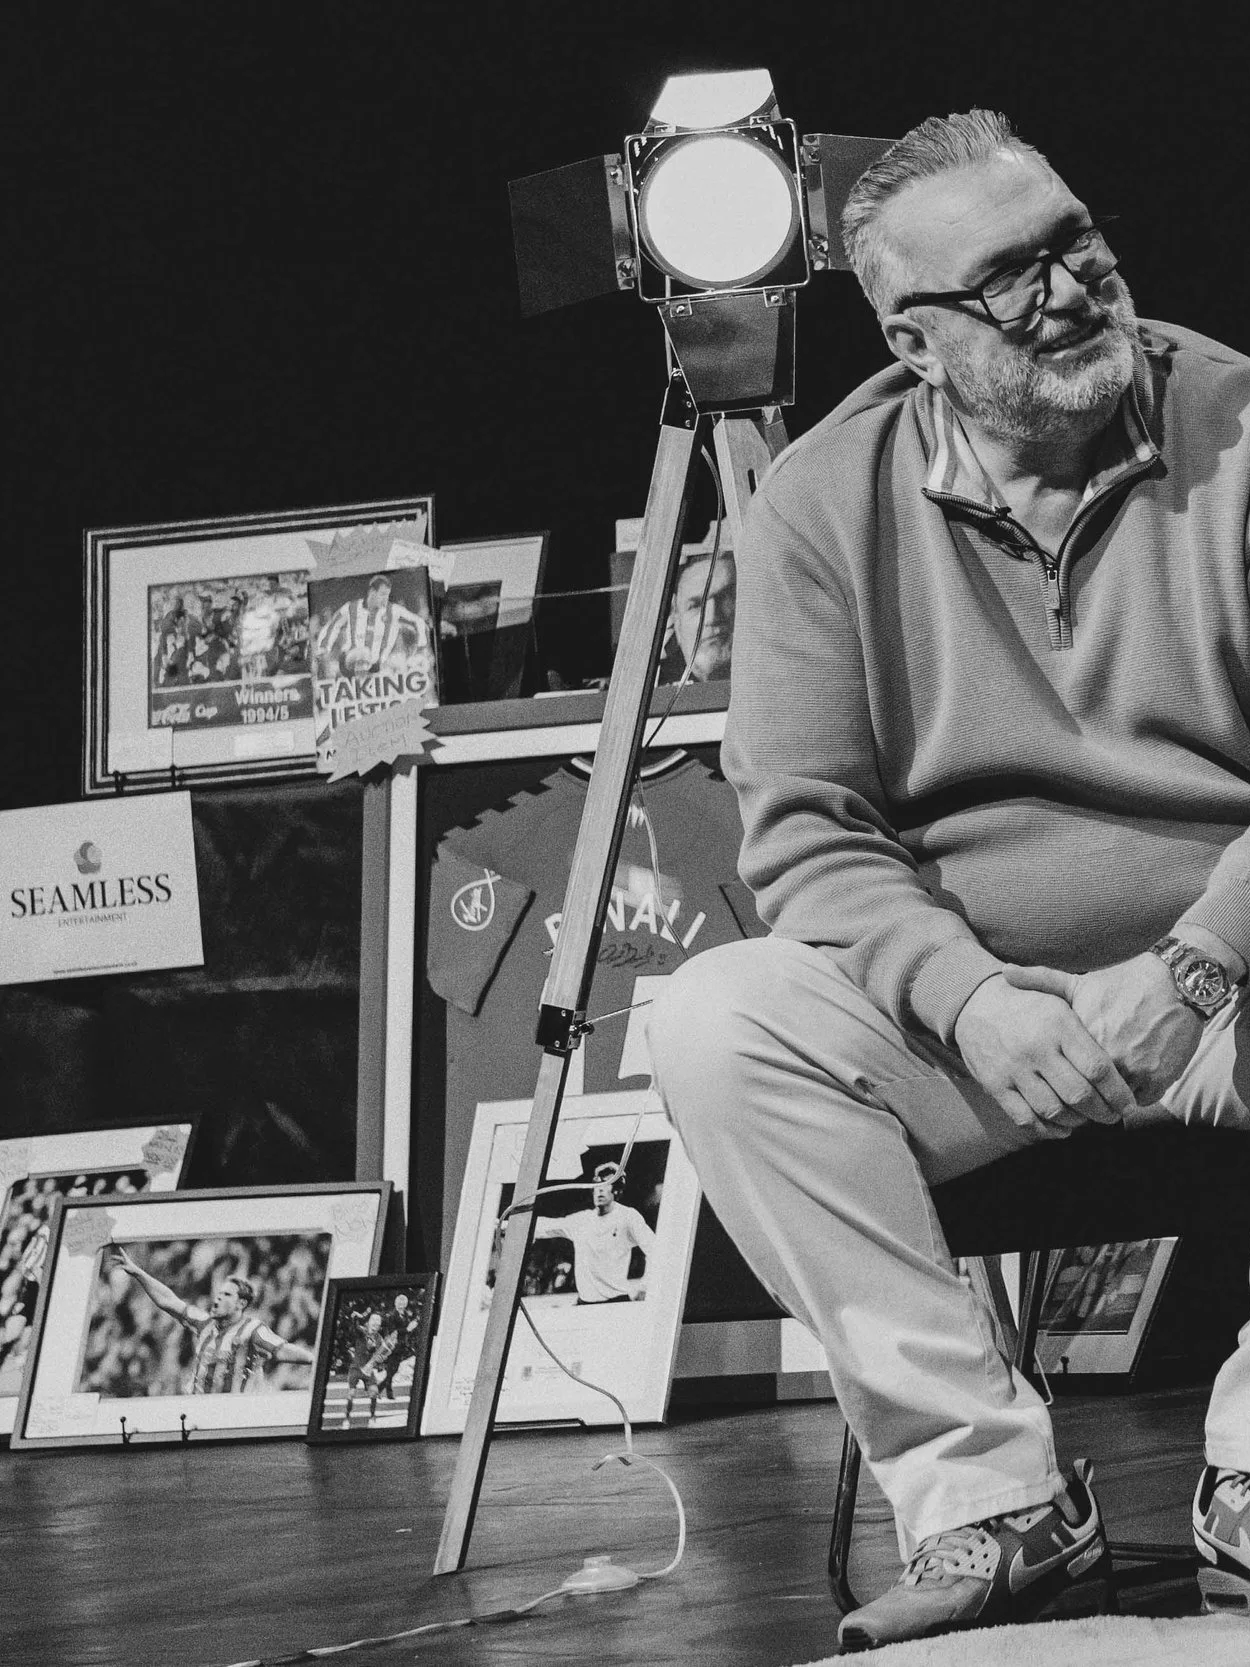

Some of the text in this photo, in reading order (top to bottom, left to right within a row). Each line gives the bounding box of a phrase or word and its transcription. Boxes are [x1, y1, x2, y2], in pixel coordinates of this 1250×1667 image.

[235, 687, 301, 706] Winners
[320, 671, 427, 704] TAKING
[240, 704, 290, 724] 1994/5
[10, 873, 172, 918] SEAMLESS
[58, 912, 128, 928] ENTERTAINMENT
